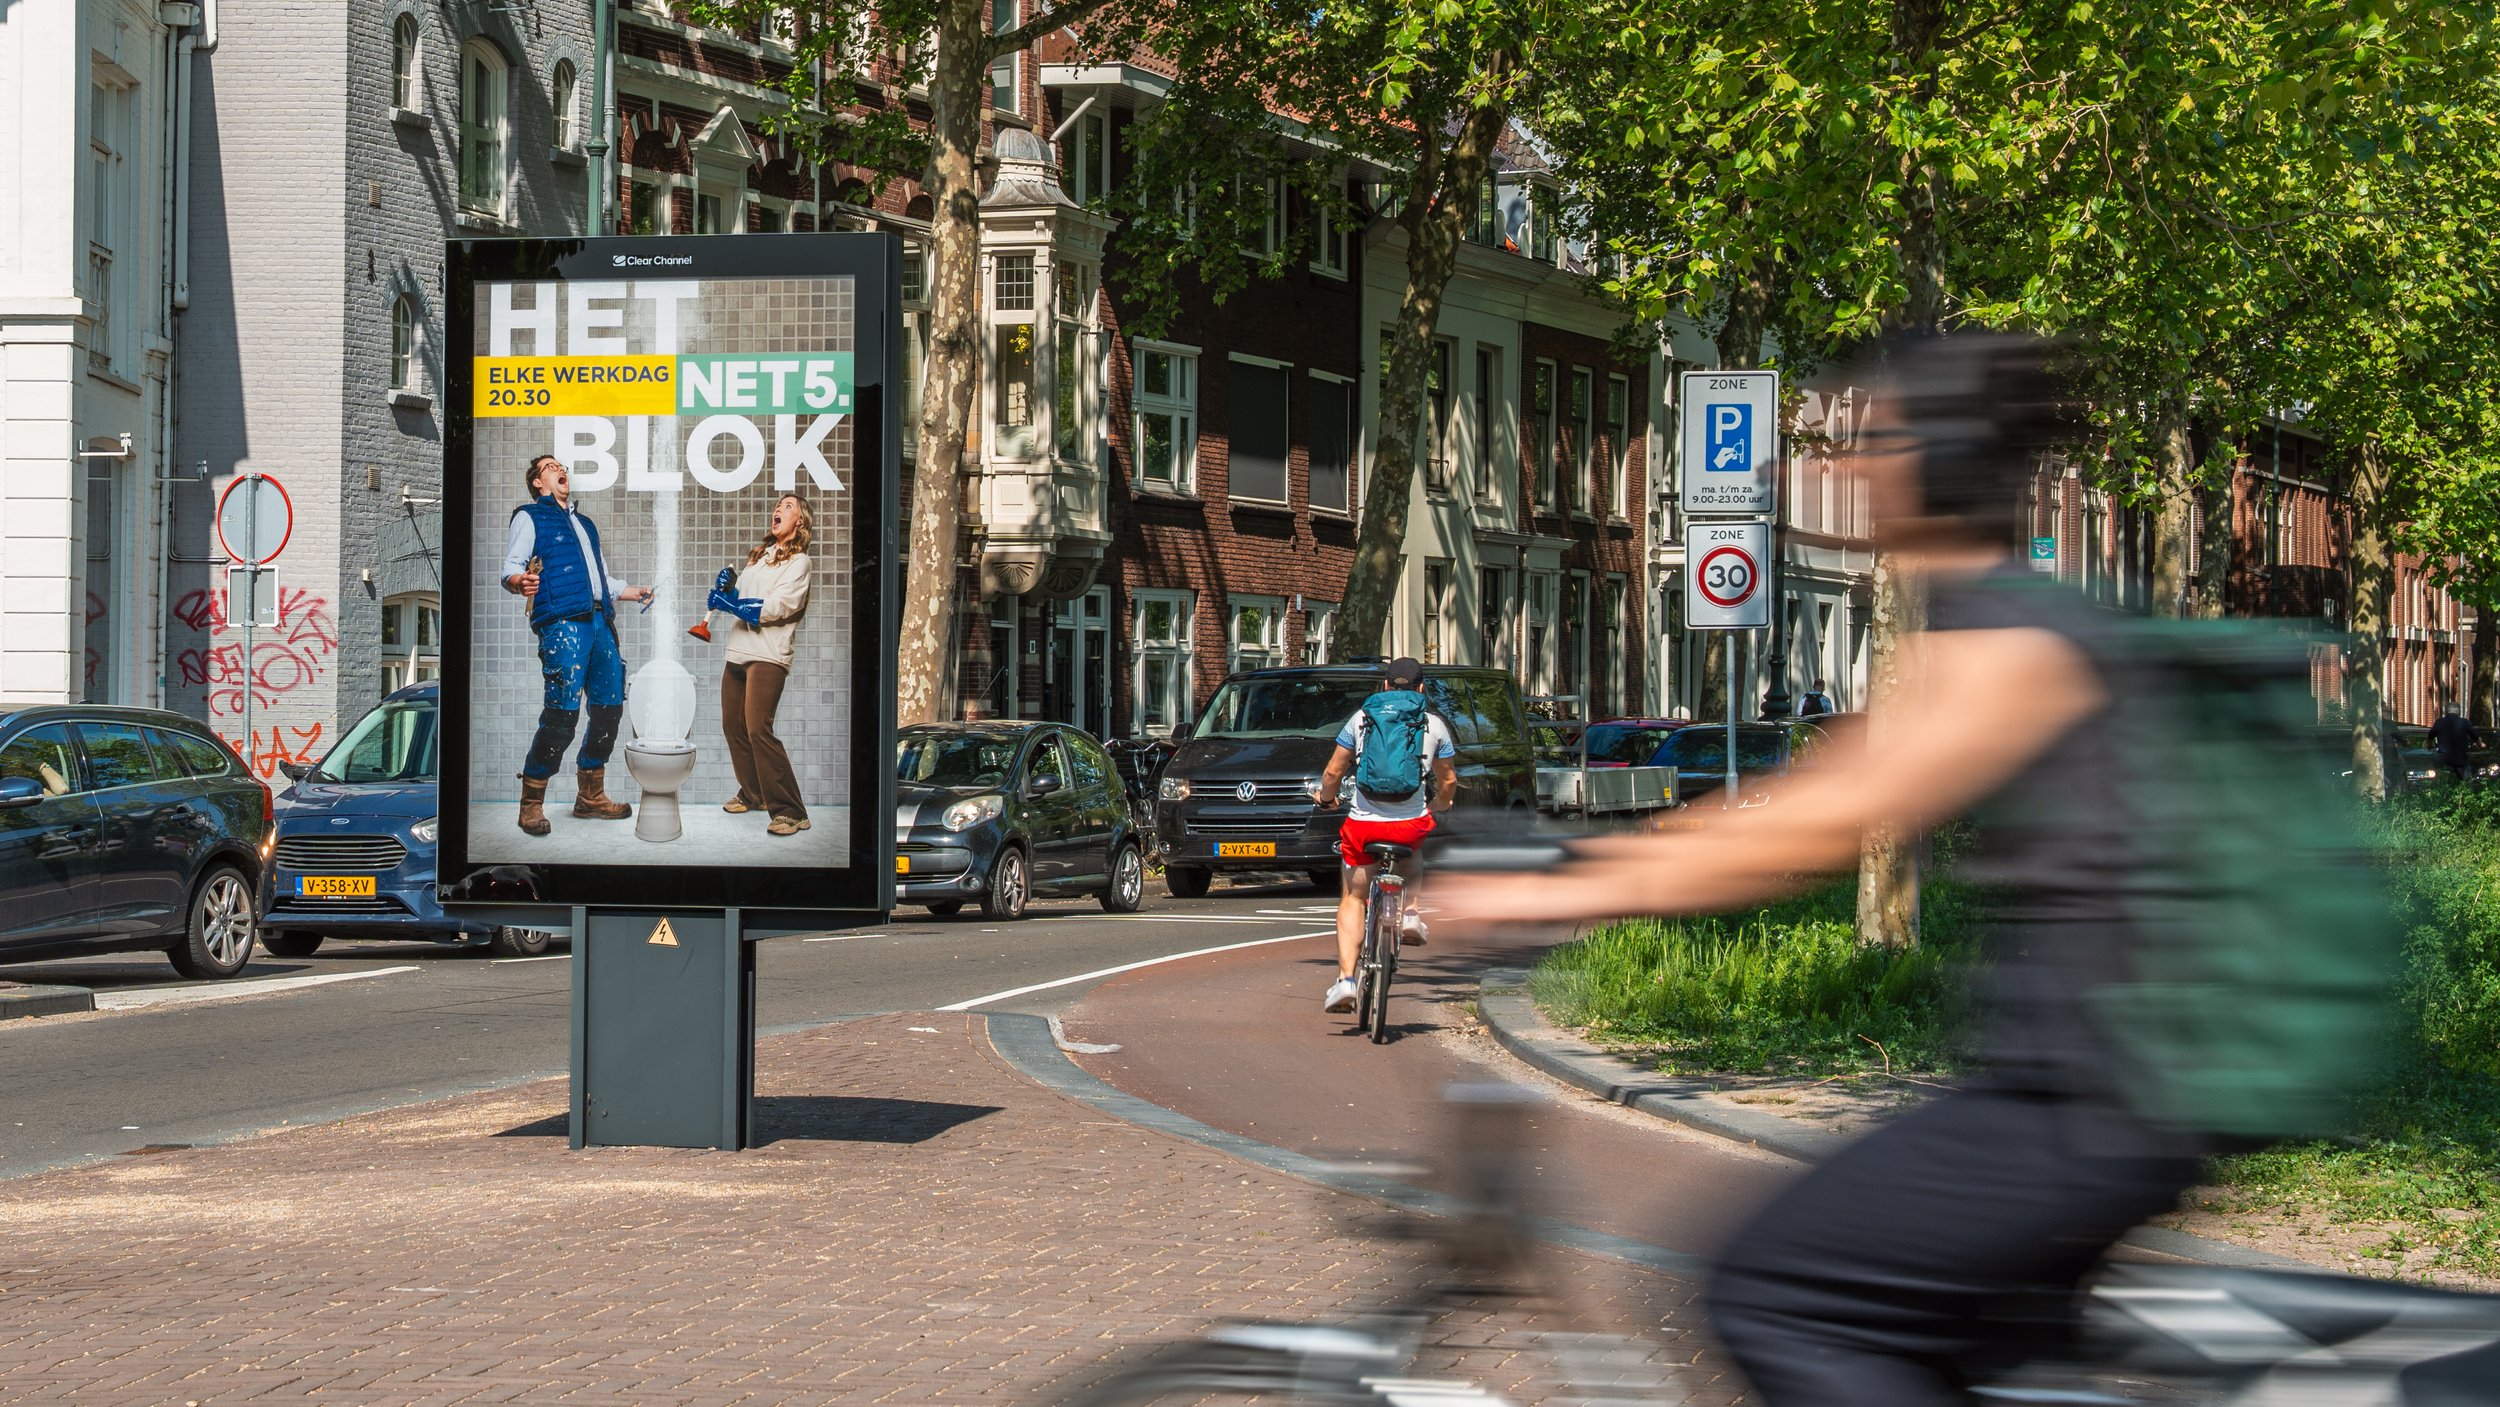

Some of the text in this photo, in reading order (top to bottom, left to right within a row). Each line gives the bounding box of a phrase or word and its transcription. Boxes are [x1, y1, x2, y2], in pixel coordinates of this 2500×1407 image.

[627, 255, 693, 266] Clear Channel
[489, 280, 700, 357] HET
[488, 364, 670, 385] ELKE WERKDAG
[1709, 378, 1748, 390] ZONE
[488, 388, 552, 407] 20.30
[1715, 406, 1743, 445] P
[554, 413, 846, 492] BLOK
[1701, 486, 1717, 494] ma.
[1720, 485, 1740, 494] t/m
[1692, 495, 1764, 504] 9.00-23.00 uur
[1710, 530, 1745, 540] ZONE
[1707, 564, 1748, 589] 30
[1222, 844, 1269, 854] 2-VXT-40
[307, 879, 370, 893] V-358-XV
